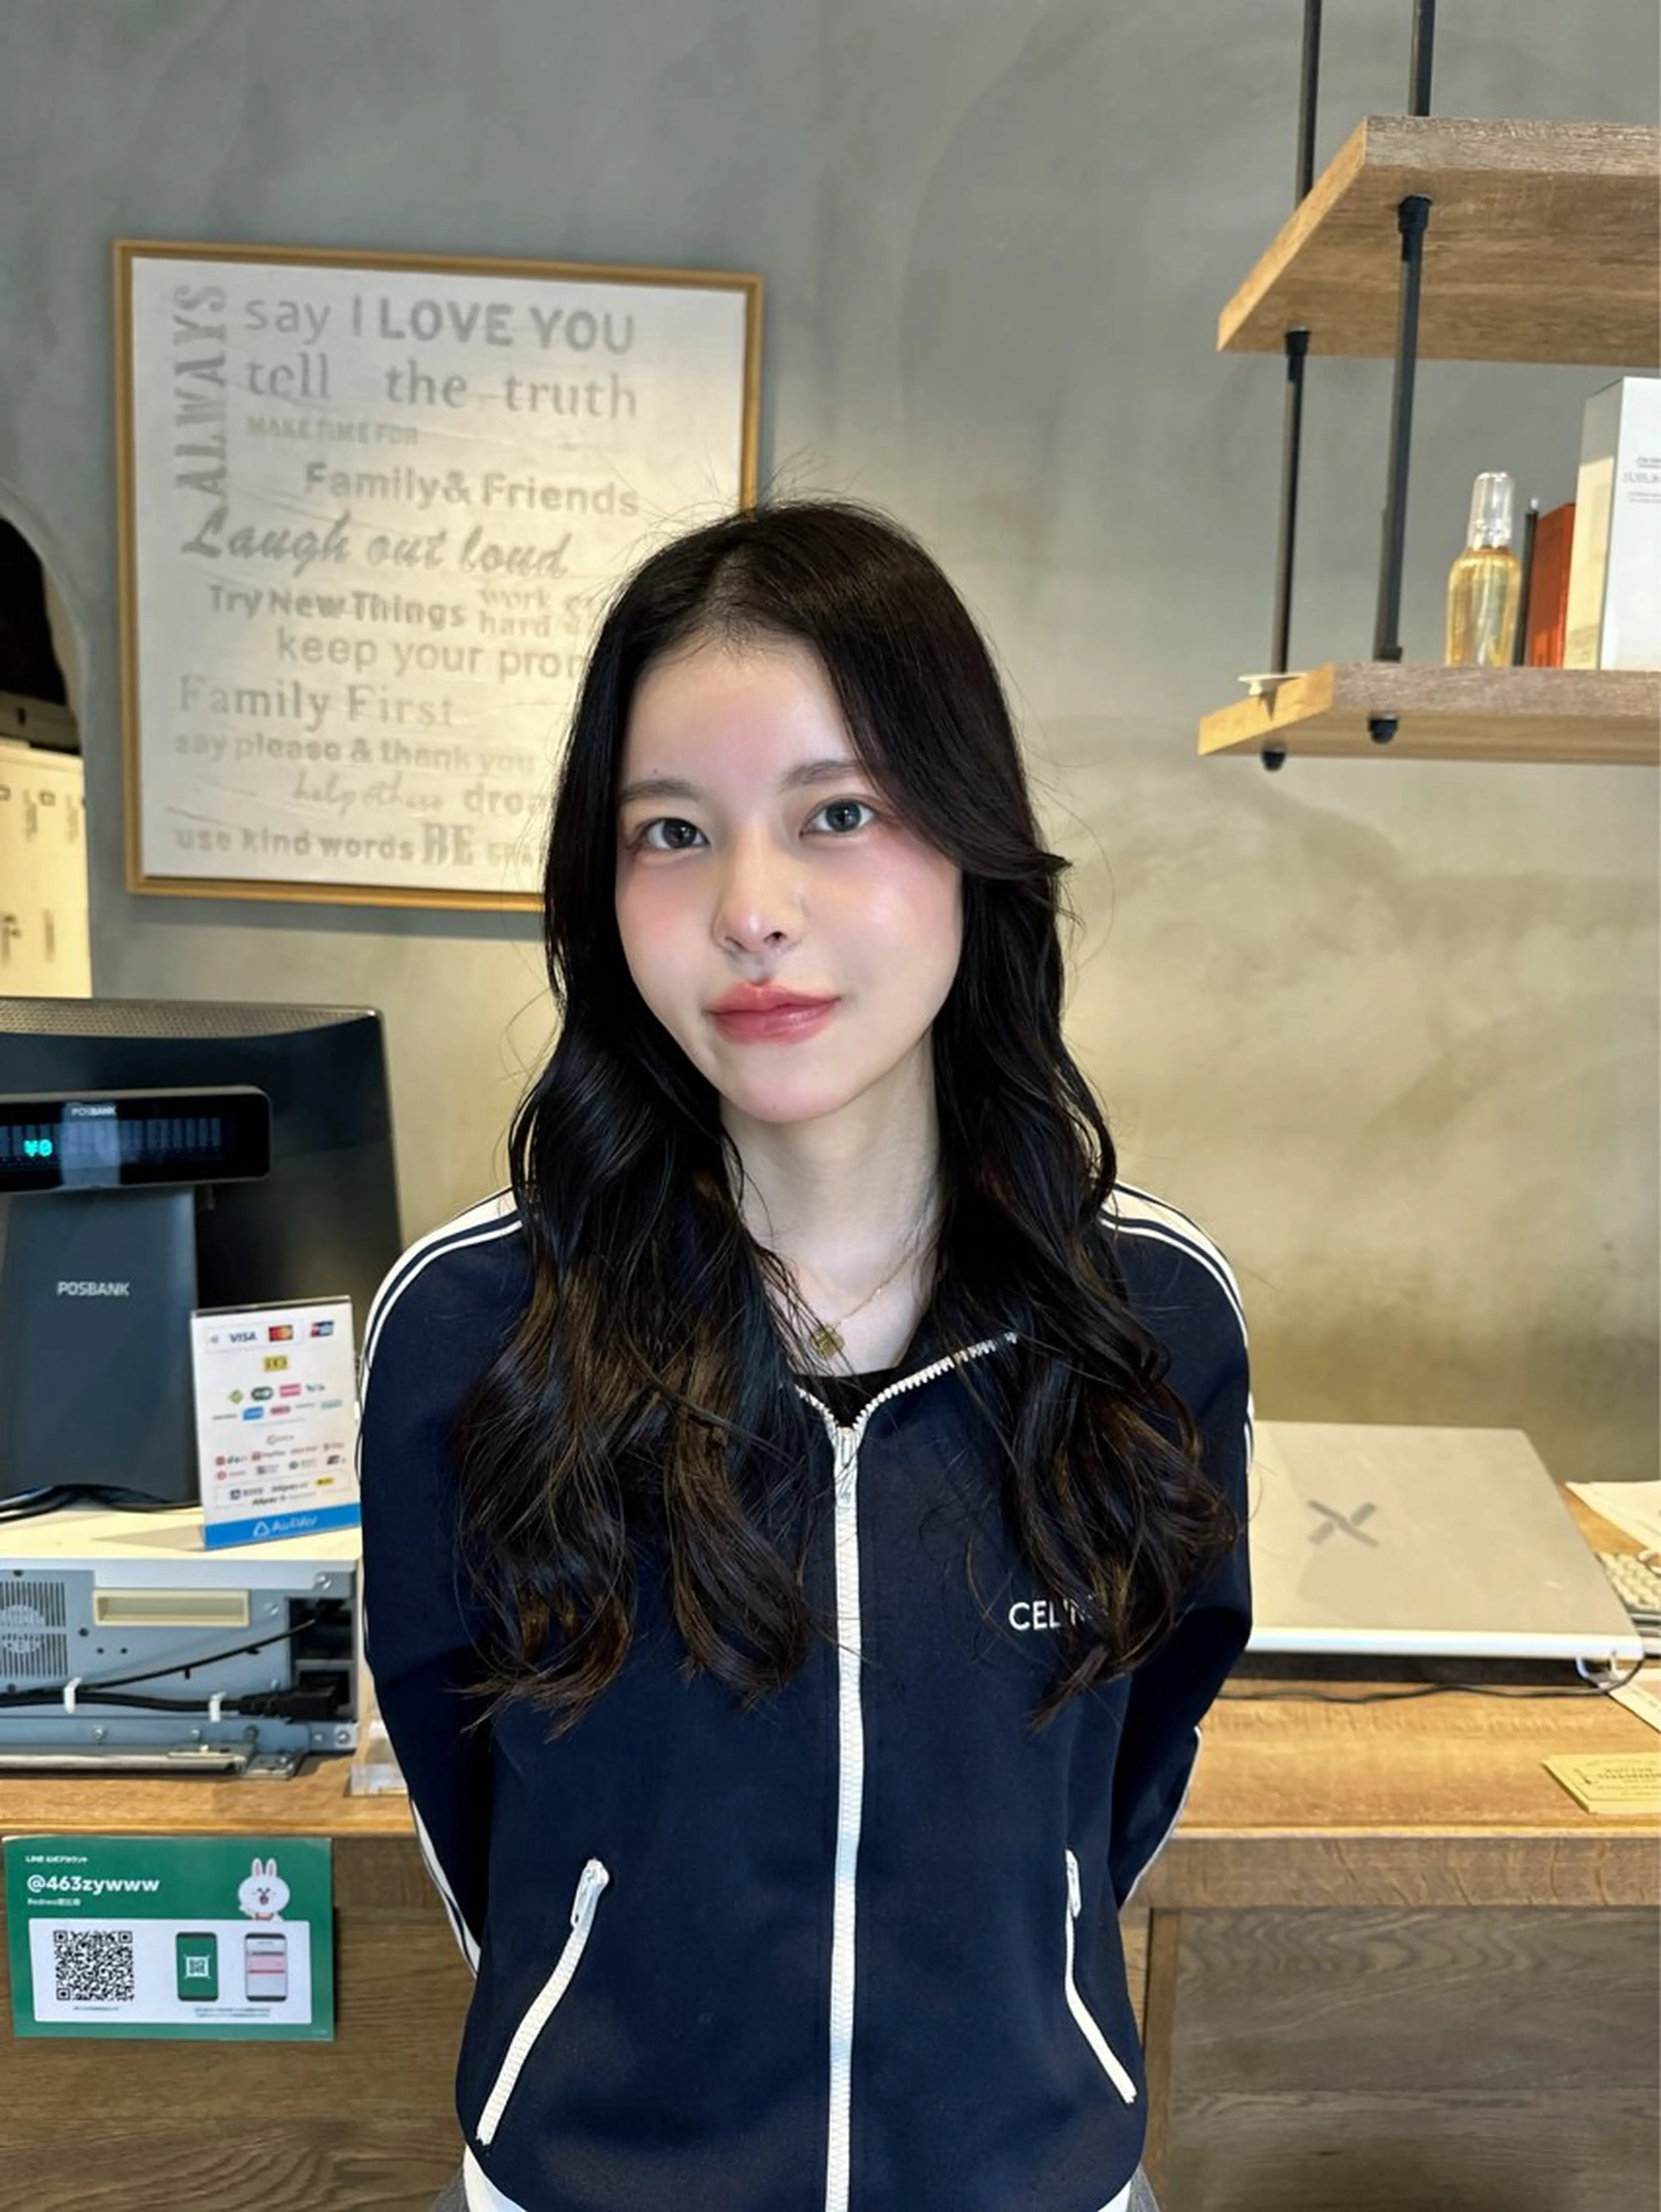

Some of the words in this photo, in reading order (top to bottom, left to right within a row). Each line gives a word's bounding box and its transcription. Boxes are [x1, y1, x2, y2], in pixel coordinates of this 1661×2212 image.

[245, 299, 330, 345] say
[352, 296, 363, 337] I
[379, 298, 514, 346] LOVE
[529, 306, 635, 354] YOU
[173, 285, 227, 496] ALWAYS
[246, 351, 330, 399] tell
[385, 359, 467, 408] the
[504, 372, 637, 419] truth
[246, 416, 310, 440] MAKE
[375, 422, 419, 446] FOR
[180, 506, 351, 577] Laugh
[367, 529, 446, 571] out
[461, 526, 571, 575] loud
[209, 585, 263, 619] Try
[269, 588, 346, 619] New
[350, 590, 467, 631] Things
[477, 587, 552, 609] work
[478, 609, 551, 638] hard
[277, 627, 378, 673] keep
[393, 640, 484, 677] your
[179, 673, 330, 732] Family
[347, 683, 453, 727] First
[175, 735, 228, 761] say
[234, 733, 341, 762] please
[350, 738, 372, 764] &
[381, 739, 471, 773] thank
[478, 750, 536, 778] you
[175, 828, 232, 851] use
[240, 827, 313, 857] kind
[317, 836, 414, 861] words
[422, 821, 476, 866] BE
[57, 1281, 130, 1298] POSBANK
[230, 1331, 257, 1343] VISA
[26, 1874, 160, 1895] @463zywww
